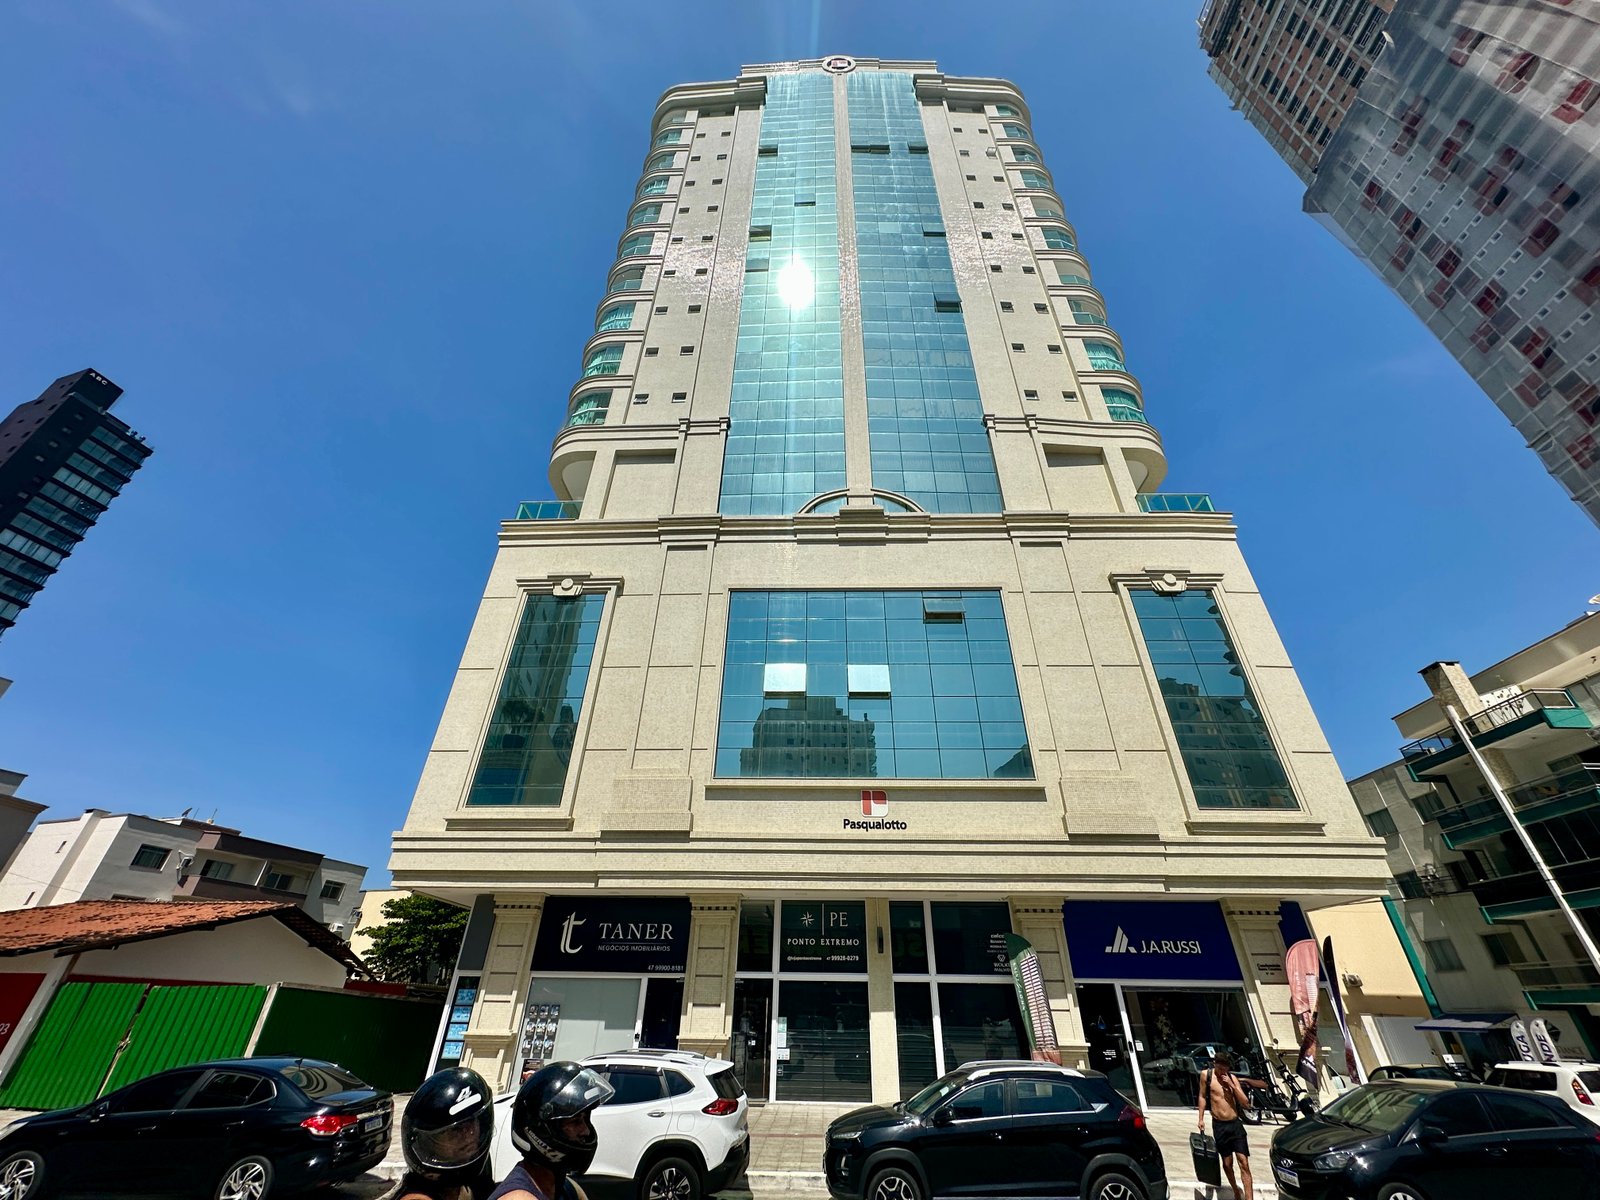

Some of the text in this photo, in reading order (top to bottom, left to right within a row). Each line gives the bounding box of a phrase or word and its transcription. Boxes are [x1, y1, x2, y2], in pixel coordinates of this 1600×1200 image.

[89, 372, 108, 386] ABC
[843, 818, 908, 832] Pasqualotto
[829, 911, 849, 927] PE
[598, 922, 674, 940] TANER
[597, 944, 630, 952] NEGÓCIOS
[787, 938, 860, 946] PONTO EXTREMO
[1140, 940, 1202, 954] J.A.RUSSI
[1516, 1034, 1534, 1061] UGA
[1535, 1034, 1556, 1062] NDE
